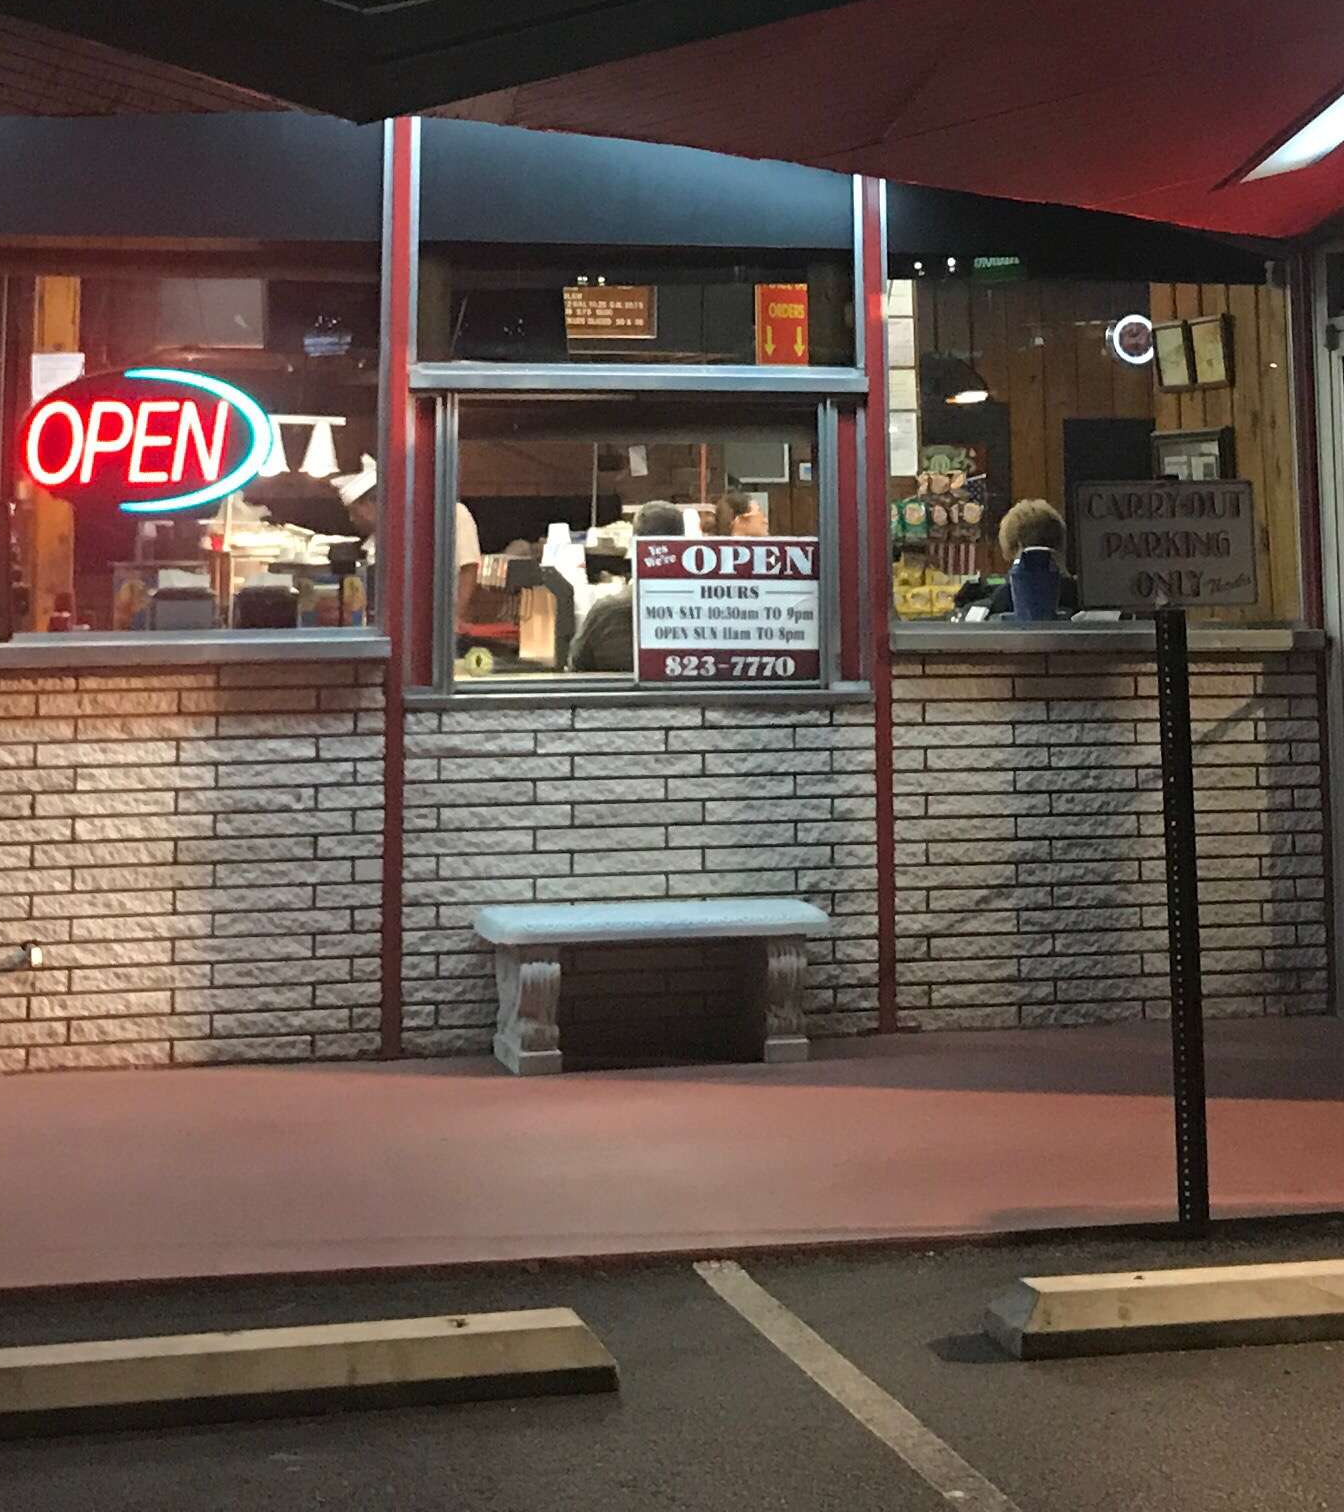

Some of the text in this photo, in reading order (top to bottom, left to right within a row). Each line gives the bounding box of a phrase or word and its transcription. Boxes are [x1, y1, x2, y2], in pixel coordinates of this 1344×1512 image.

[768, 302, 805, 319] ORDERS
[27, 400, 230, 485] OPEN
[1087, 489, 1245, 520] CARRY-OUT
[1101, 529, 1232, 559] PARKING
[681, 544, 815, 575] OPEN
[700, 585, 760, 600] HOURS
[1135, 569, 1203, 598] ONLY
[764, 606, 782, 620] TO
[787, 606, 814, 624] 9pm
[654, 626, 689, 640] OPEN
[694, 626, 718, 640] SUN
[757, 626, 774, 640] TO
[778, 626, 805, 644] 8pm
[665, 655, 796, 677] 823-7770
